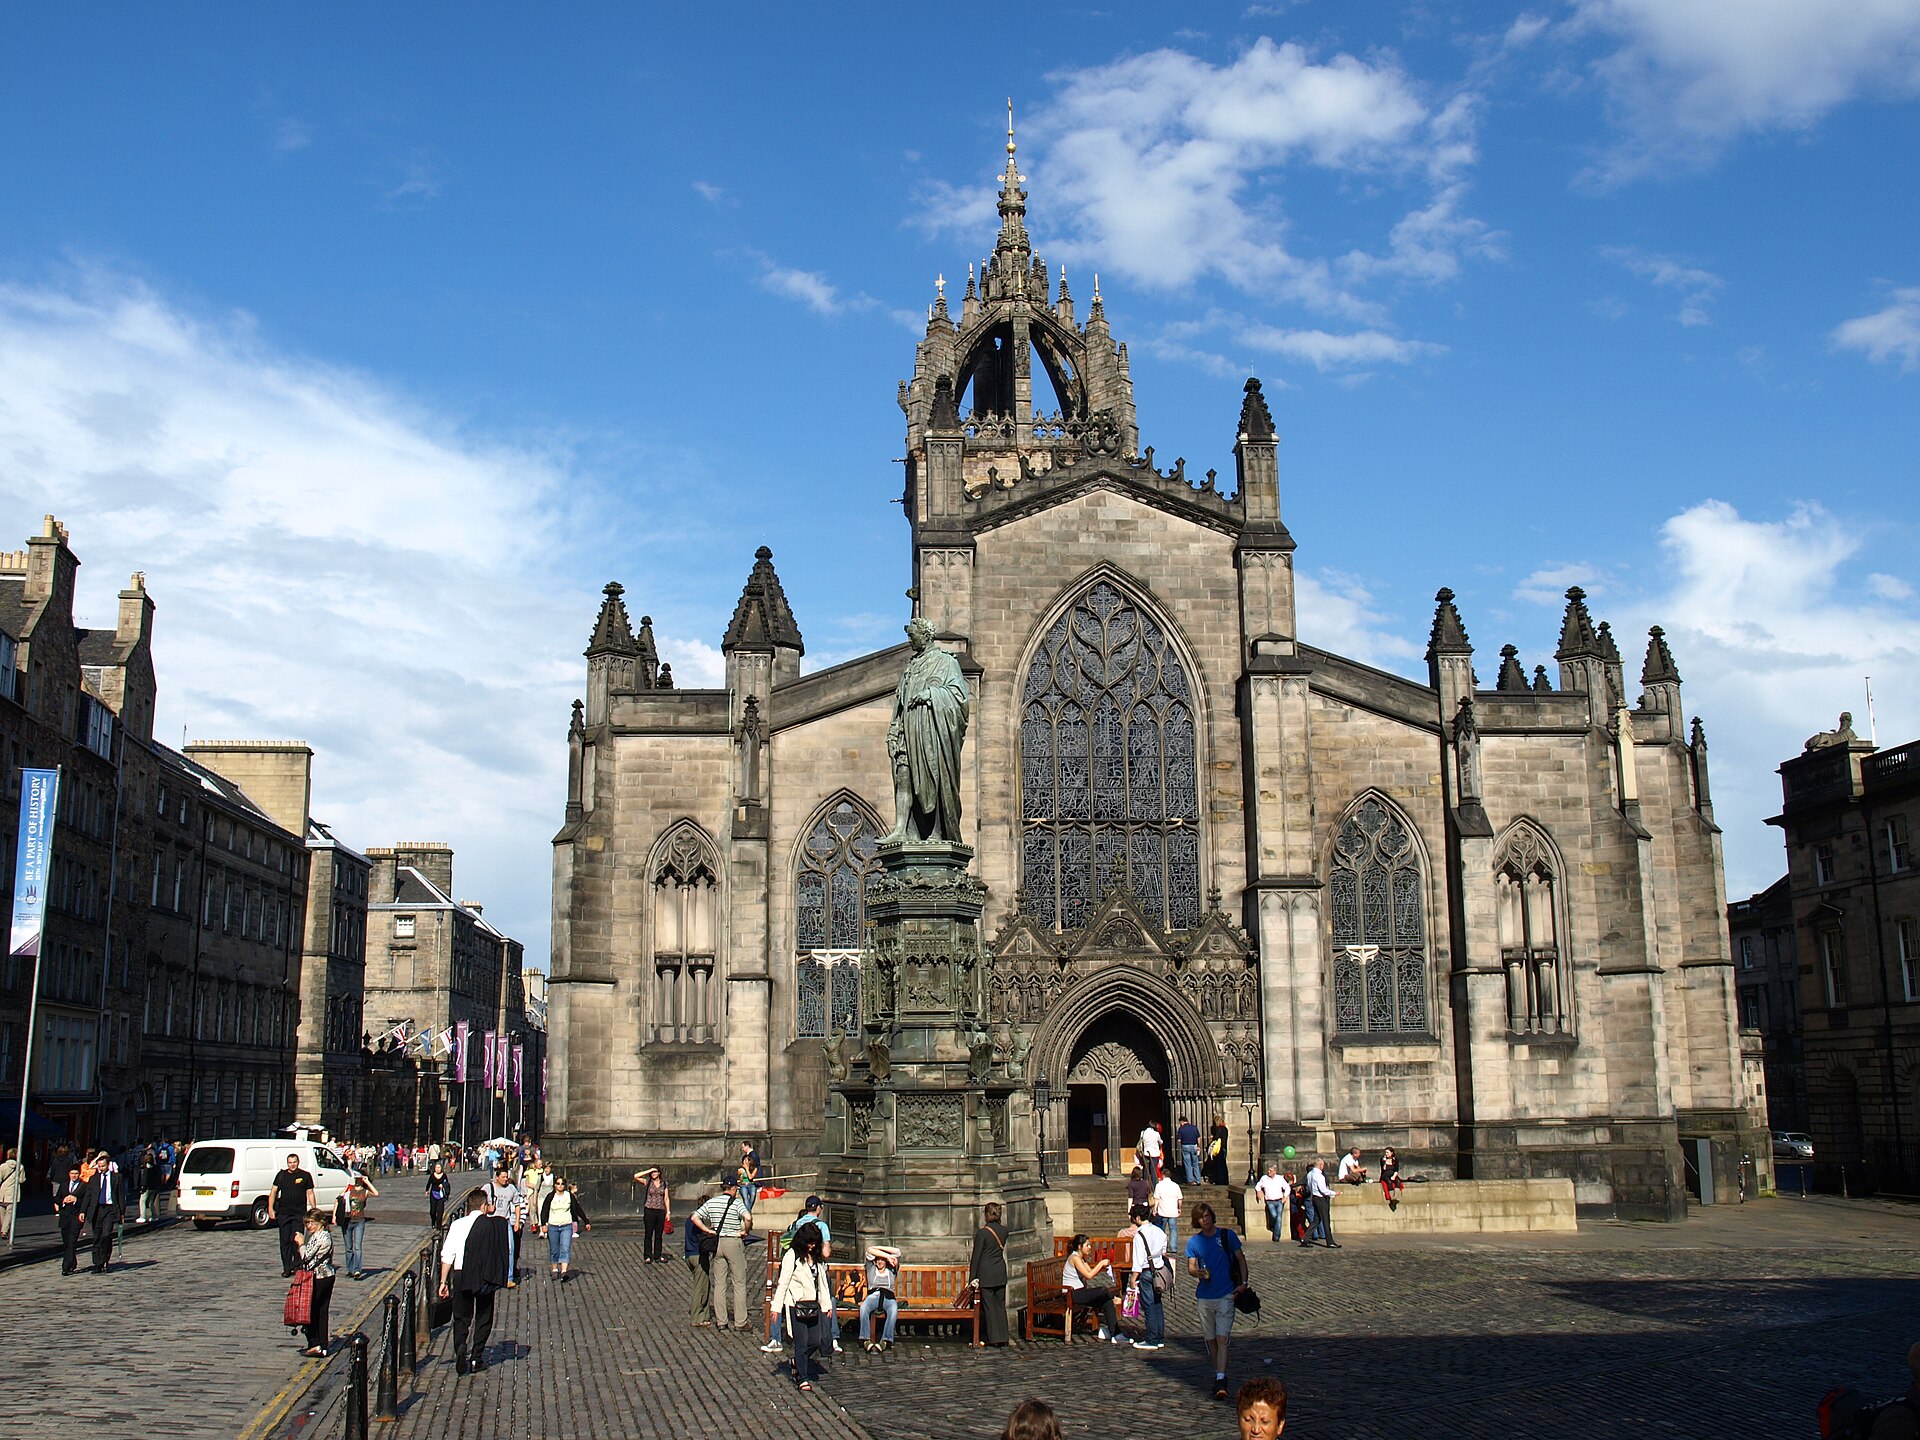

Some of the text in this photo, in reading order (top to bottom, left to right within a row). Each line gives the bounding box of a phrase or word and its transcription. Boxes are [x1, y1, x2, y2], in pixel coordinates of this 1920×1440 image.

[29, 776, 41, 818] HISTORY
[28, 821, 38, 834] OF
[26, 835, 37, 859] PART
[25, 869, 34, 881] BE
